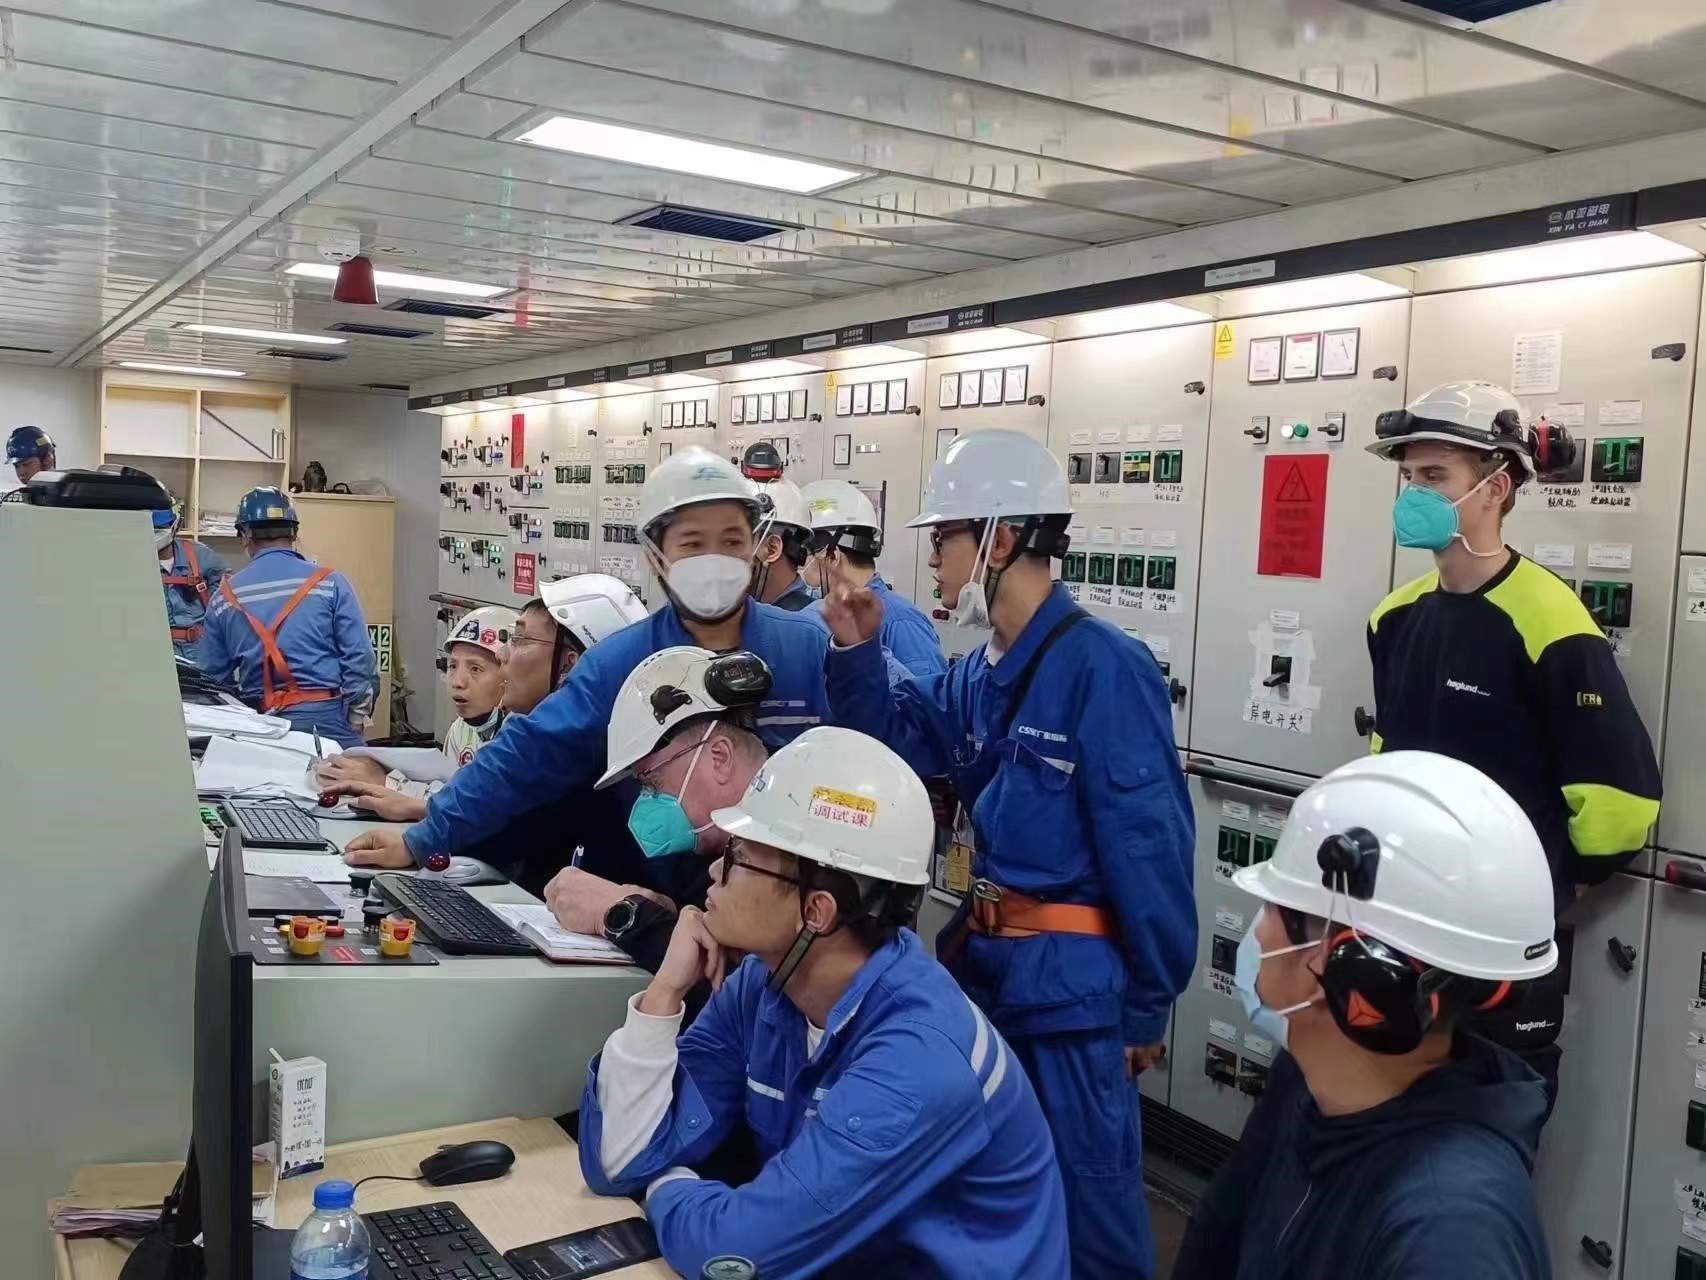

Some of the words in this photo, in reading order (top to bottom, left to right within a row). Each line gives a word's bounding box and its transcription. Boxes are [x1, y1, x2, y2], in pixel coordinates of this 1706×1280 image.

[1548, 225, 1563, 233] XIN
[1564, 223, 1576, 232] YA
[1588, 218, 1609, 228] DIAN
[813, 804, 868, 827] 调试课
[1515, 1019, 1547, 1032] høglund
